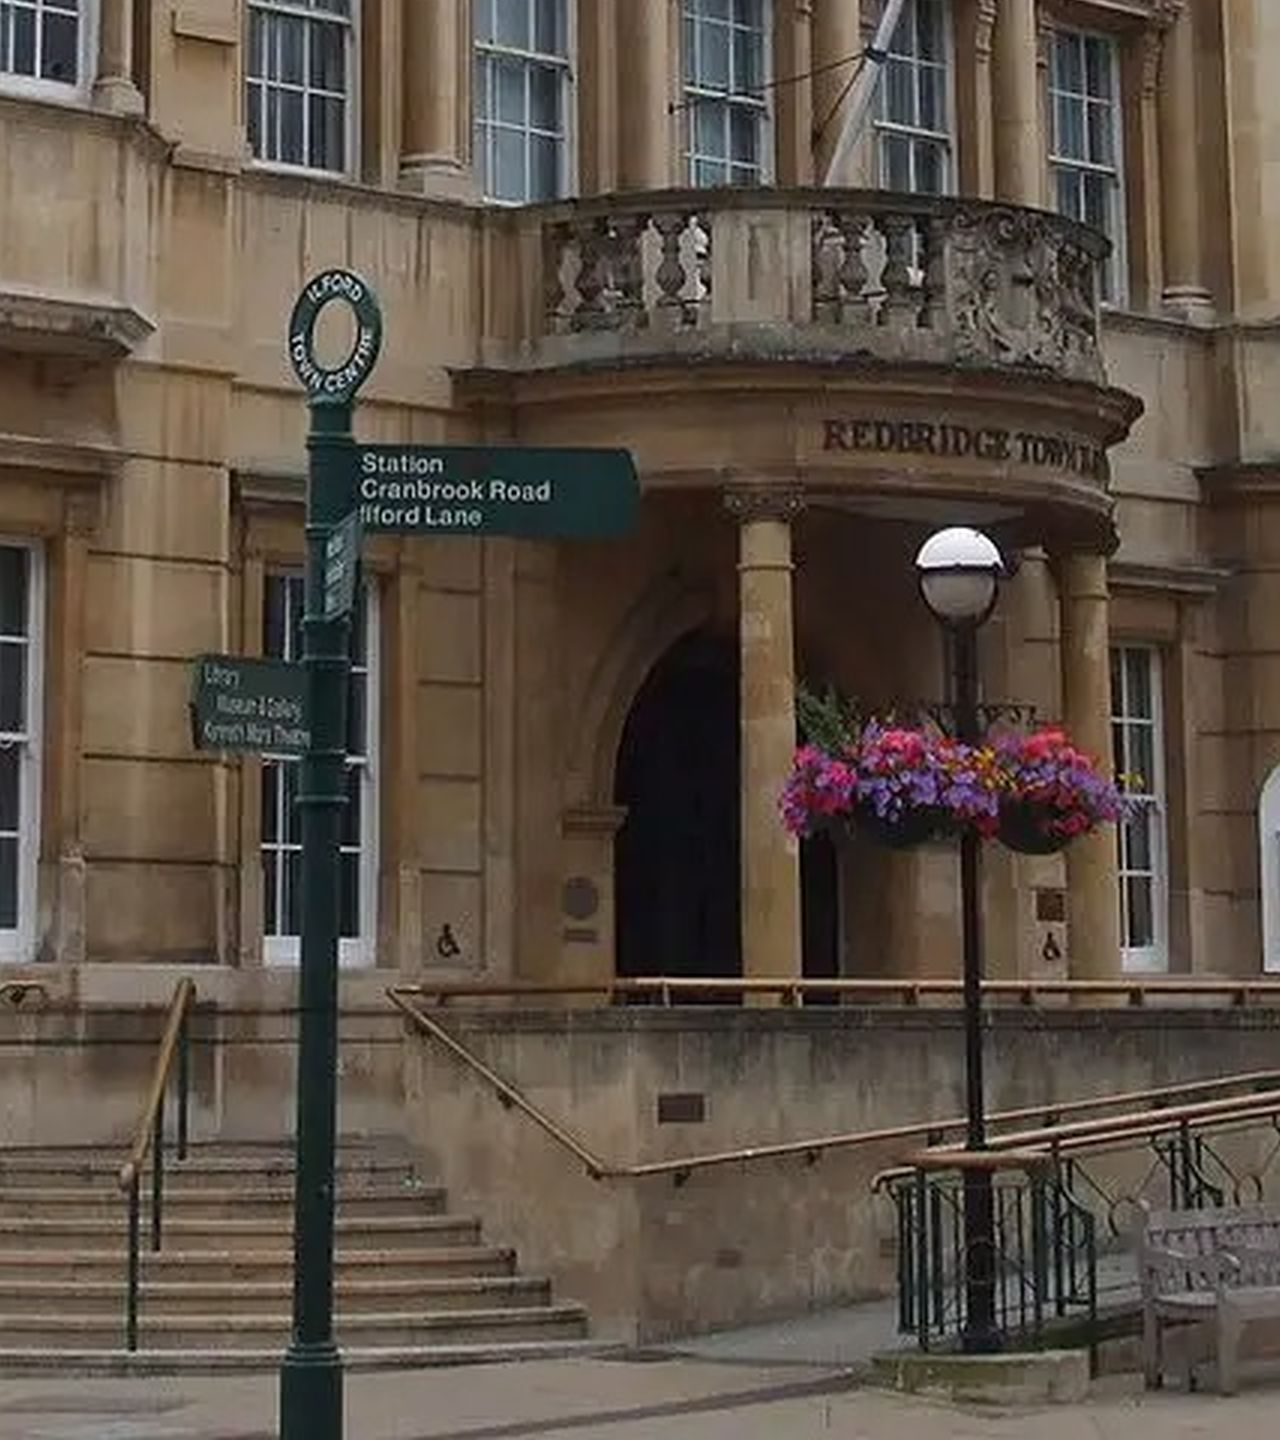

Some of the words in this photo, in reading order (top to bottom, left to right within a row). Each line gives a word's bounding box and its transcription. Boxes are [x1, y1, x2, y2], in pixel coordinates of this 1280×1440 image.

[306, 273, 362, 302] ILFORD
[291, 332, 323, 389] TOWN
[821, 418, 1011, 459] REDBRIDGE
[361, 452, 444, 474] Station
[360, 477, 484, 501] Cranbrook
[489, 478, 552, 502] Road
[359, 503, 420, 526] Ilford
[425, 505, 483, 527] Lane
